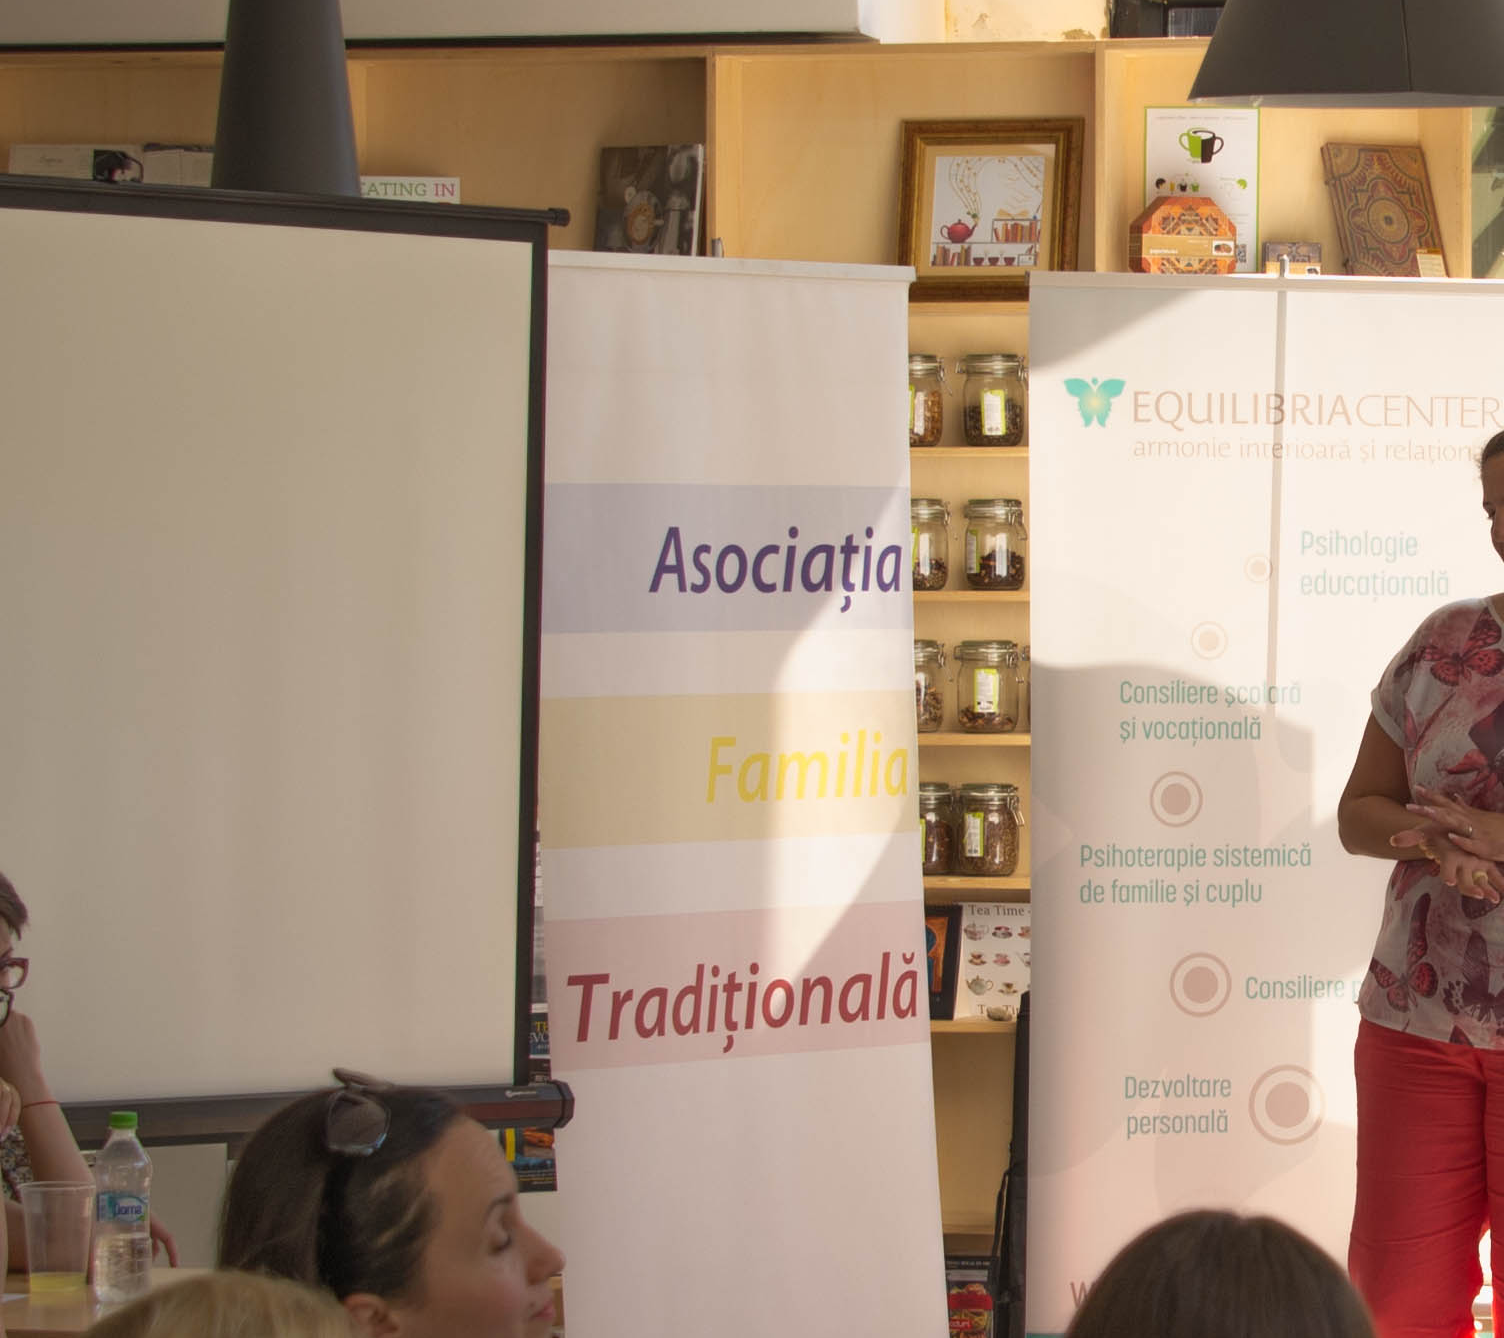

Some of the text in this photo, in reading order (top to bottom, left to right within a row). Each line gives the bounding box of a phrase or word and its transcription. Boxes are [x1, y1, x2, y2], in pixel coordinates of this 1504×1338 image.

[433, 182, 456, 198] IN
[1133, 437, 1231, 460] armonie
[1384, 439, 1483, 466] relaționa
[1300, 529, 1418, 564] Psihologie
[649, 525, 903, 614] Asociația
[1300, 569, 1449, 602] educațională
[1119, 679, 1302, 712] Consiliere școlară
[1119, 715, 1262, 748] și vocațională
[706, 730, 909, 804] Familia
[1080, 842, 1312, 872] Psihoterapie sistemică
[1080, 878, 1263, 909] de familie și cuplu
[968, 904, 1025, 917] Tea Time
[567, 951, 918, 1054] Tradițională
[1245, 974, 1345, 1000] Consiliere
[1124, 1074, 1232, 1101] Dezvoltare
[1126, 1108, 1229, 1140] personală
